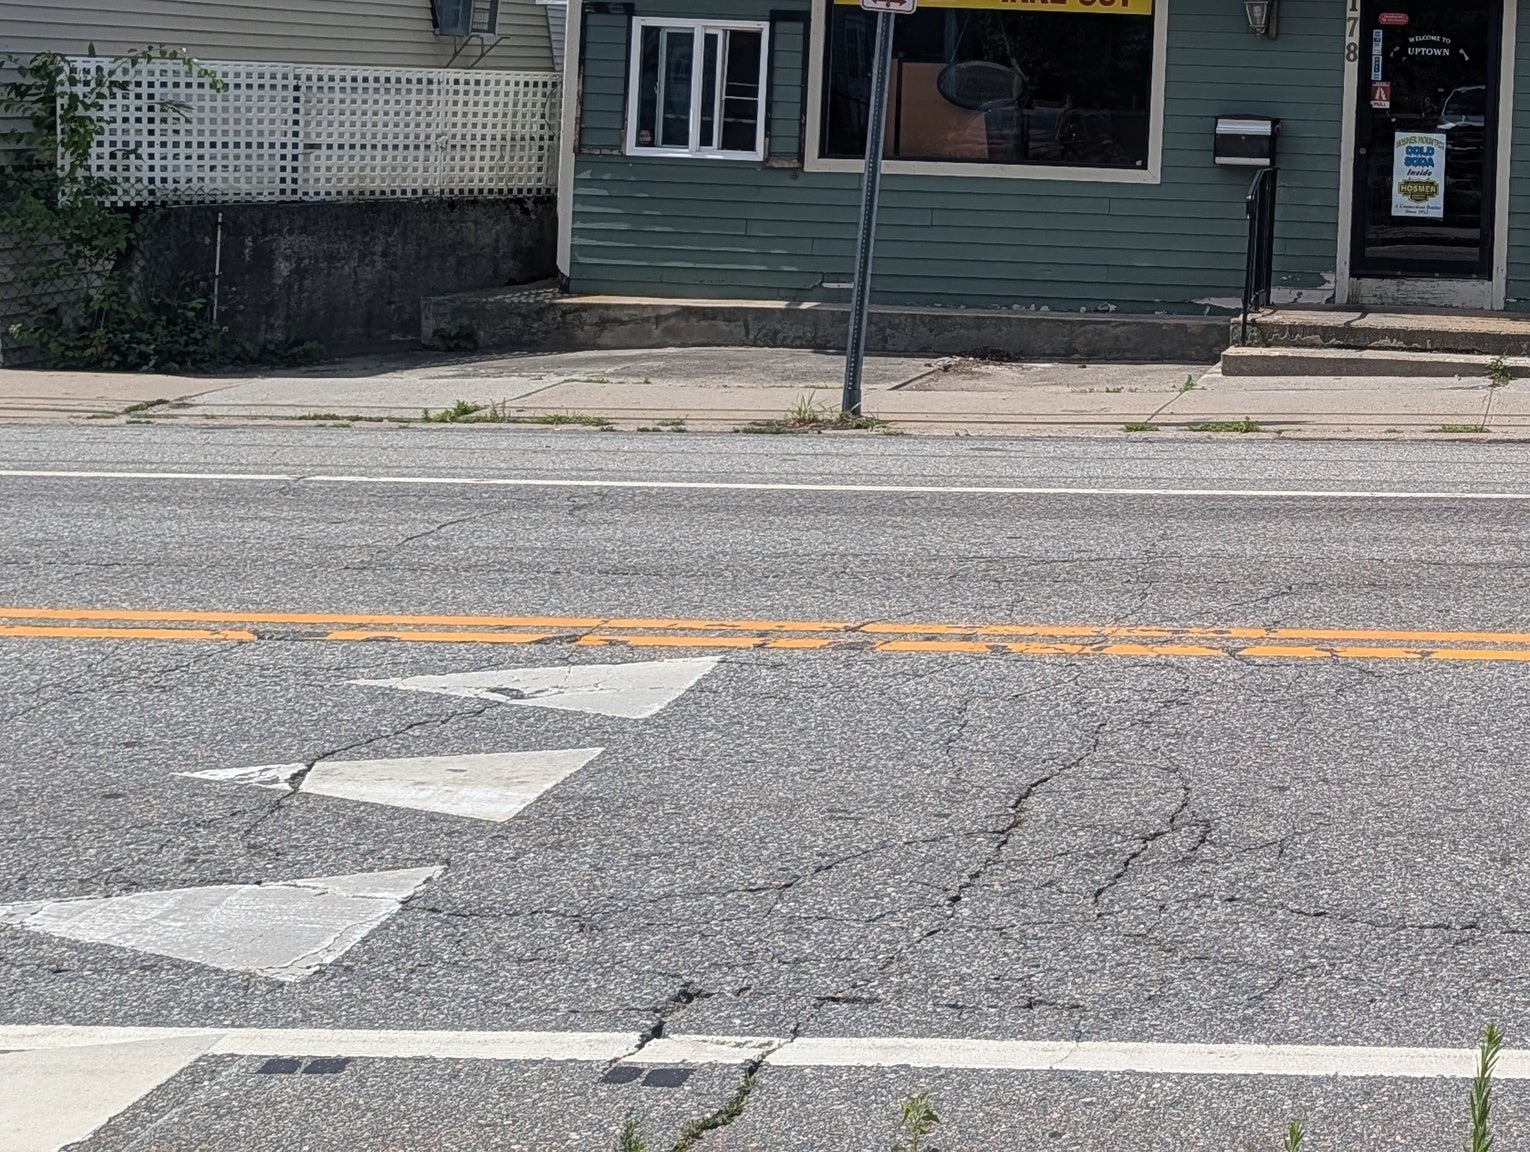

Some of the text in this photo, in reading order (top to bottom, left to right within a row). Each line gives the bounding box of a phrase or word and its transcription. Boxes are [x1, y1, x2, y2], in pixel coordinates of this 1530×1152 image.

[1408, 35, 1441, 43] WELCOME
[1408, 47, 1450, 56] UPTOWN
[1400, 185, 1436, 193] HOSMER
